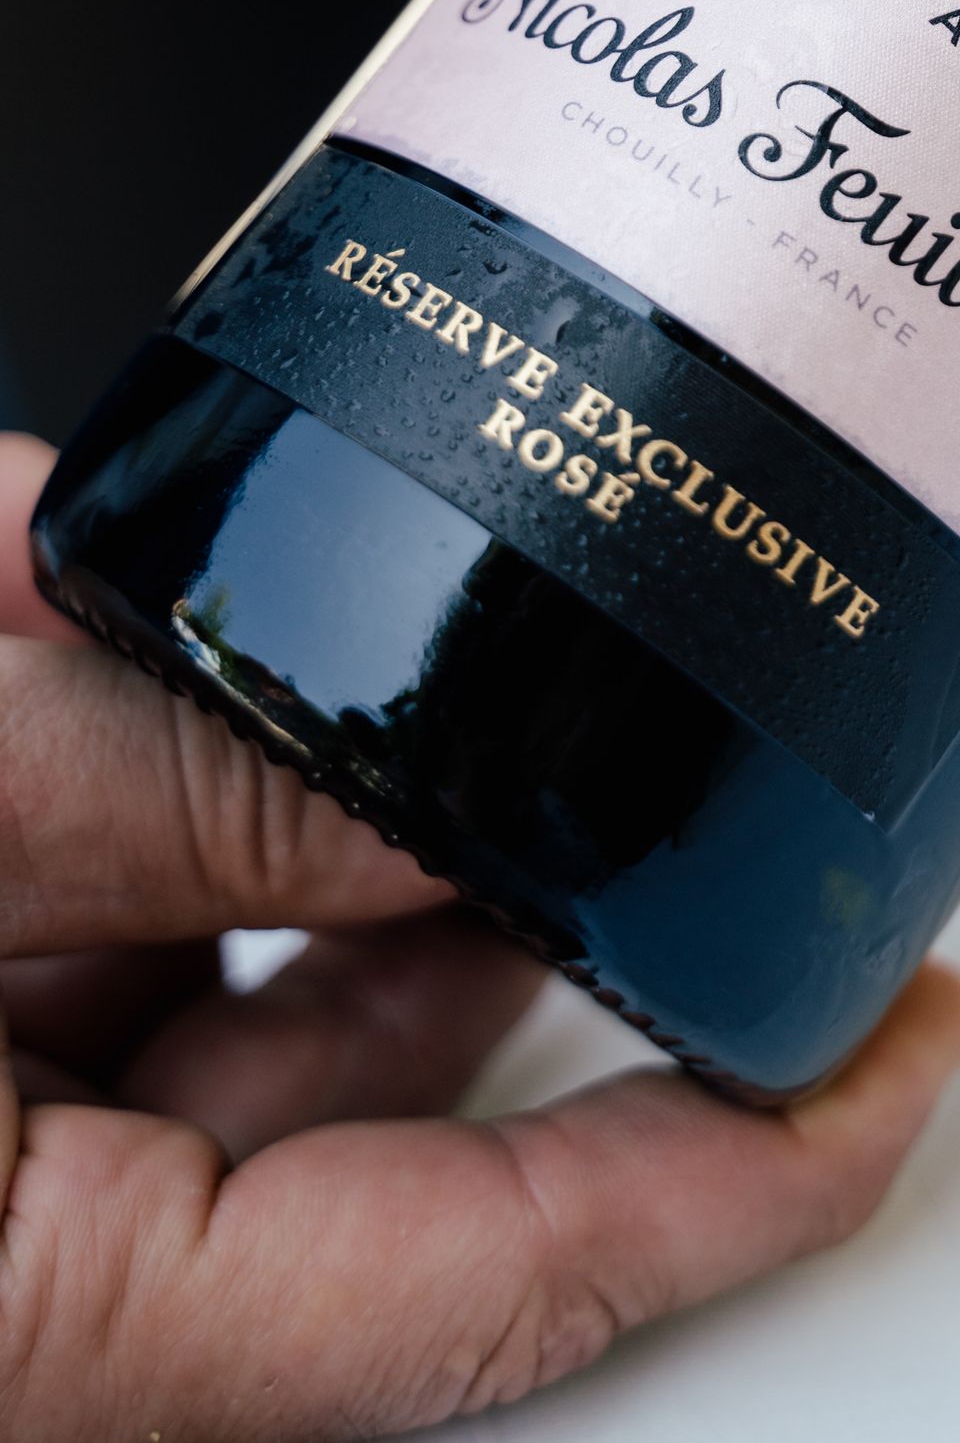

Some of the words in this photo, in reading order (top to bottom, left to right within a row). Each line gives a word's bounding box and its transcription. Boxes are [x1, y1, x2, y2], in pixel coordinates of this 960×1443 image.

[561, 101, 733, 210] CHOUILLY
[771, 230, 919, 349] FRANCE
[324, 239, 560, 400] RÉSERVE
[560, 383, 882, 640] EXCLUSIVE
[478, 399, 641, 524] ROSÉ
